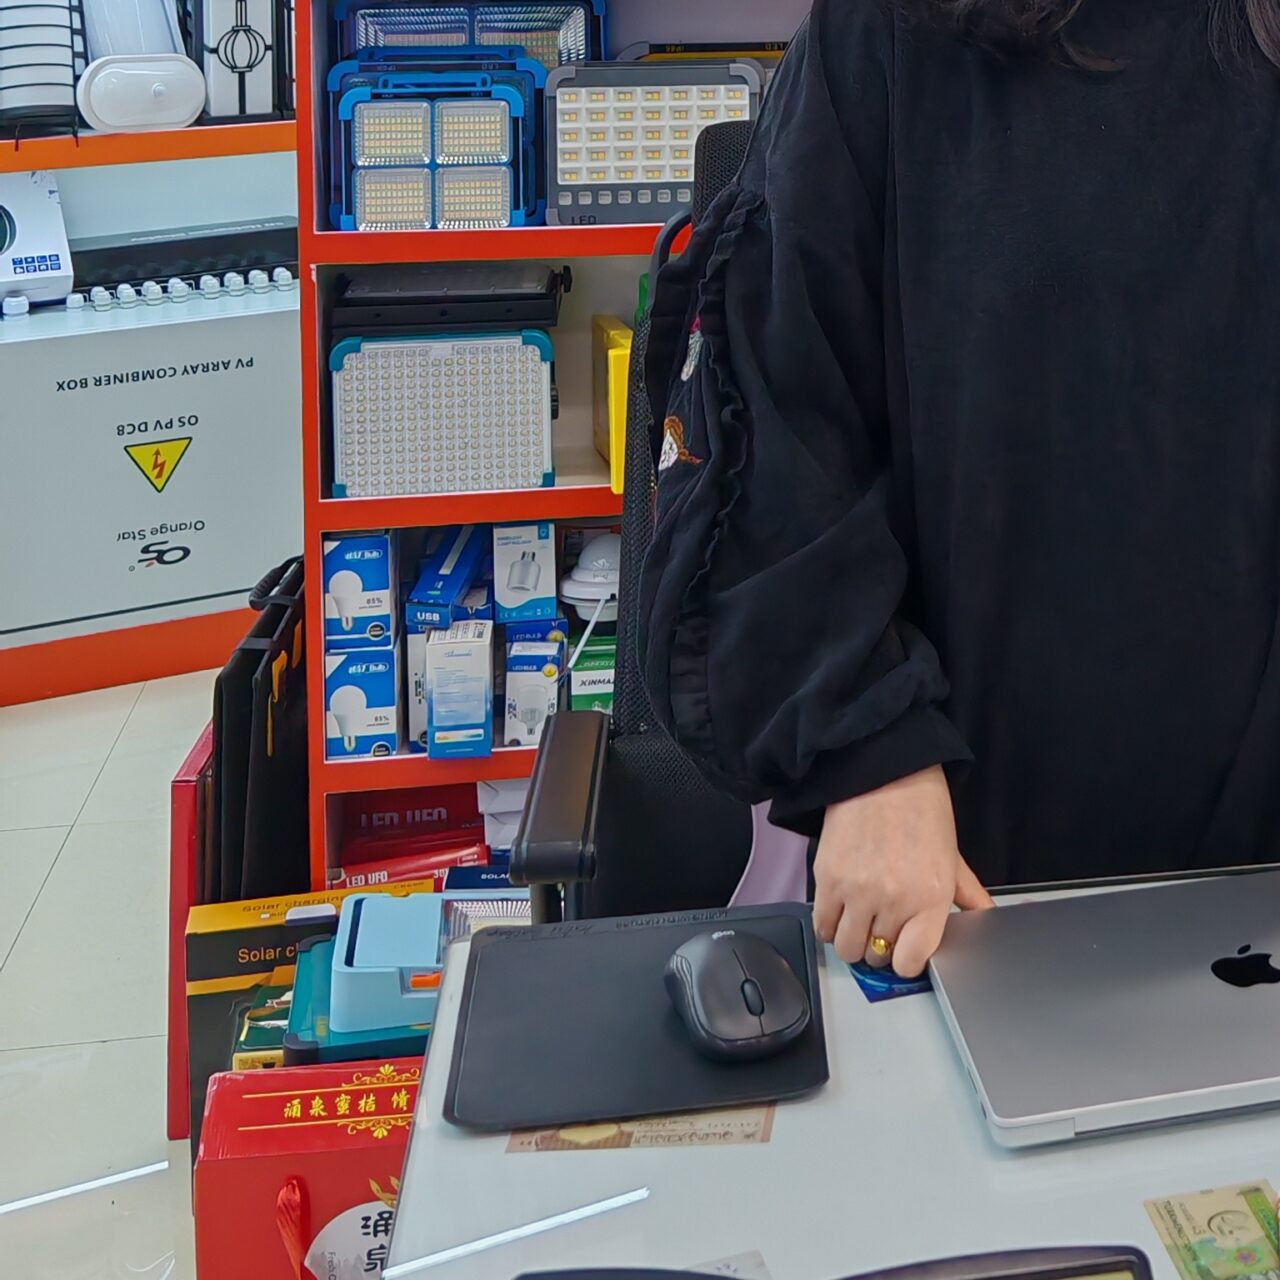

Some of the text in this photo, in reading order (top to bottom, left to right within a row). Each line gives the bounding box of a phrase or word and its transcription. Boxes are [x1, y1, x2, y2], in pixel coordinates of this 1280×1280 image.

[571, 214, 597, 225] LED
[55, 356, 255, 393] PV ARRAY COMBINER BOX
[115, 414, 200, 437] OS PV DC8
[115, 519, 206, 543] Orange Star
[416, 611, 440, 621] USB
[579, 678, 615, 687] XINMA
[346, 870, 388, 888] LED UFO
[241, 901, 282, 912] Solar
[237, 946, 283, 964] Solar
[283, 1093, 377, 1119] 涌泉蜜桔
